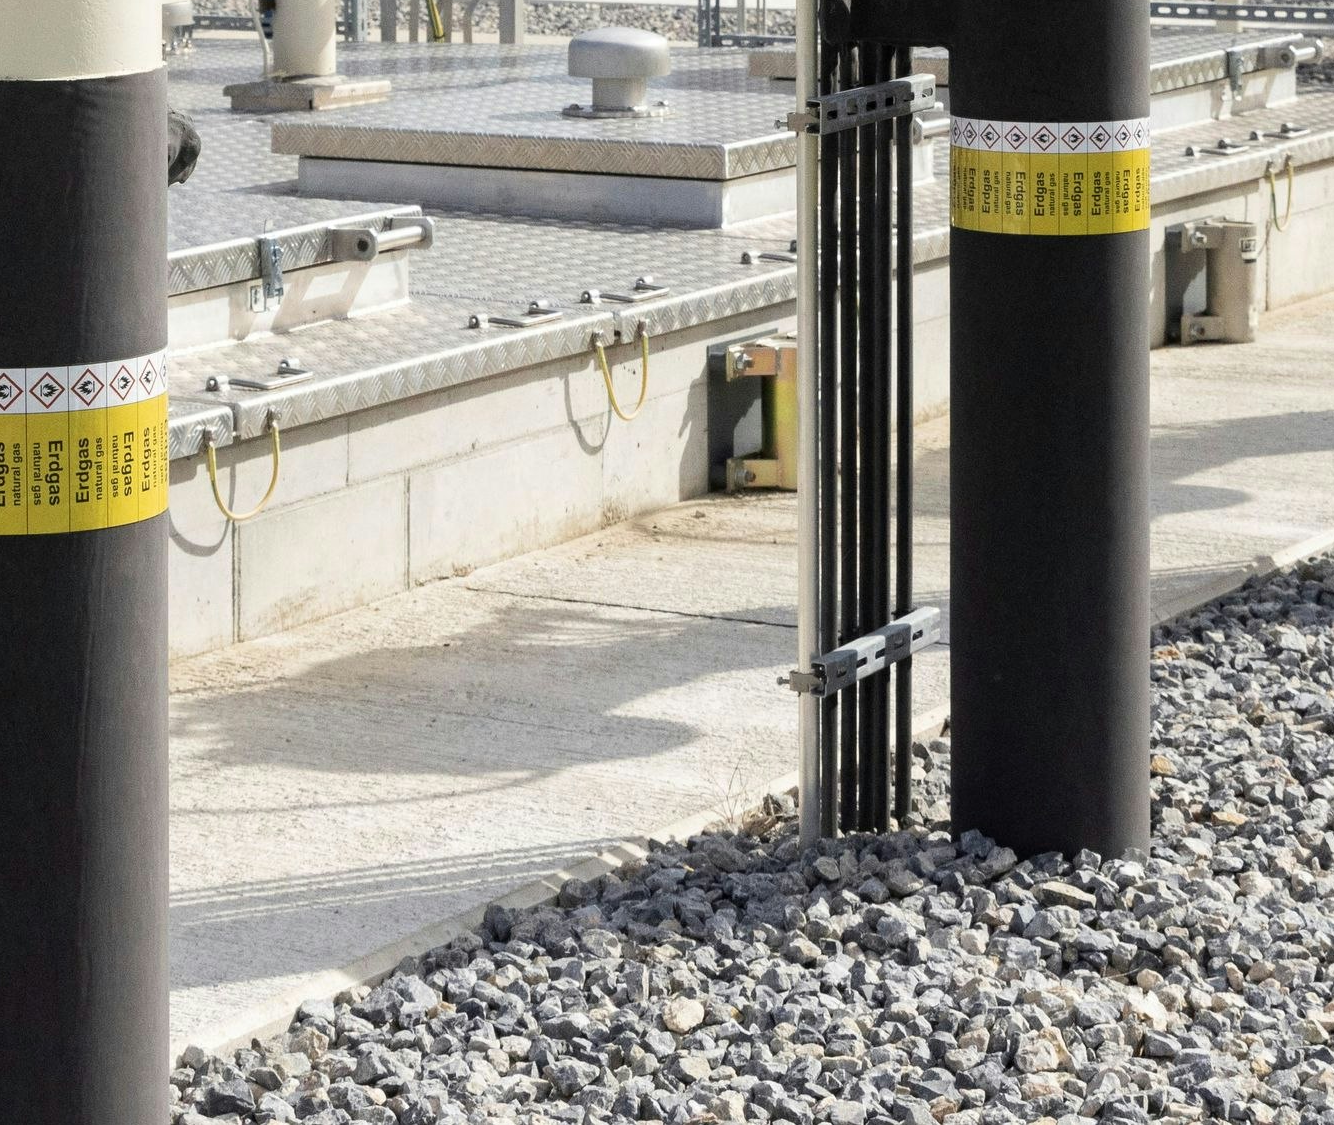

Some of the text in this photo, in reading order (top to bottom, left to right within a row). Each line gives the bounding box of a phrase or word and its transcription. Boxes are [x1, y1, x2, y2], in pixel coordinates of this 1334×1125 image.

[982, 170, 992, 213] Erdgas
[1013, 171, 1026, 215] Erdgas
[1034, 172, 1047, 216] Erdgas
[1071, 172, 1083, 216] Erdgas
[1092, 171, 1103, 215] Erdgas
[1122, 170, 1130, 214] Erdgas
[11, 443, 22, 506] natural gas
[31, 442, 43, 506] natural gas
[45, 440, 63, 506] Erdgas
[76, 437, 92, 503] Erdgas
[94, 437, 104, 500] natural gas
[111, 435, 120, 498] natural gas
[121, 431, 134, 497] Erdgas
[141, 427, 151, 492] Erdgas
